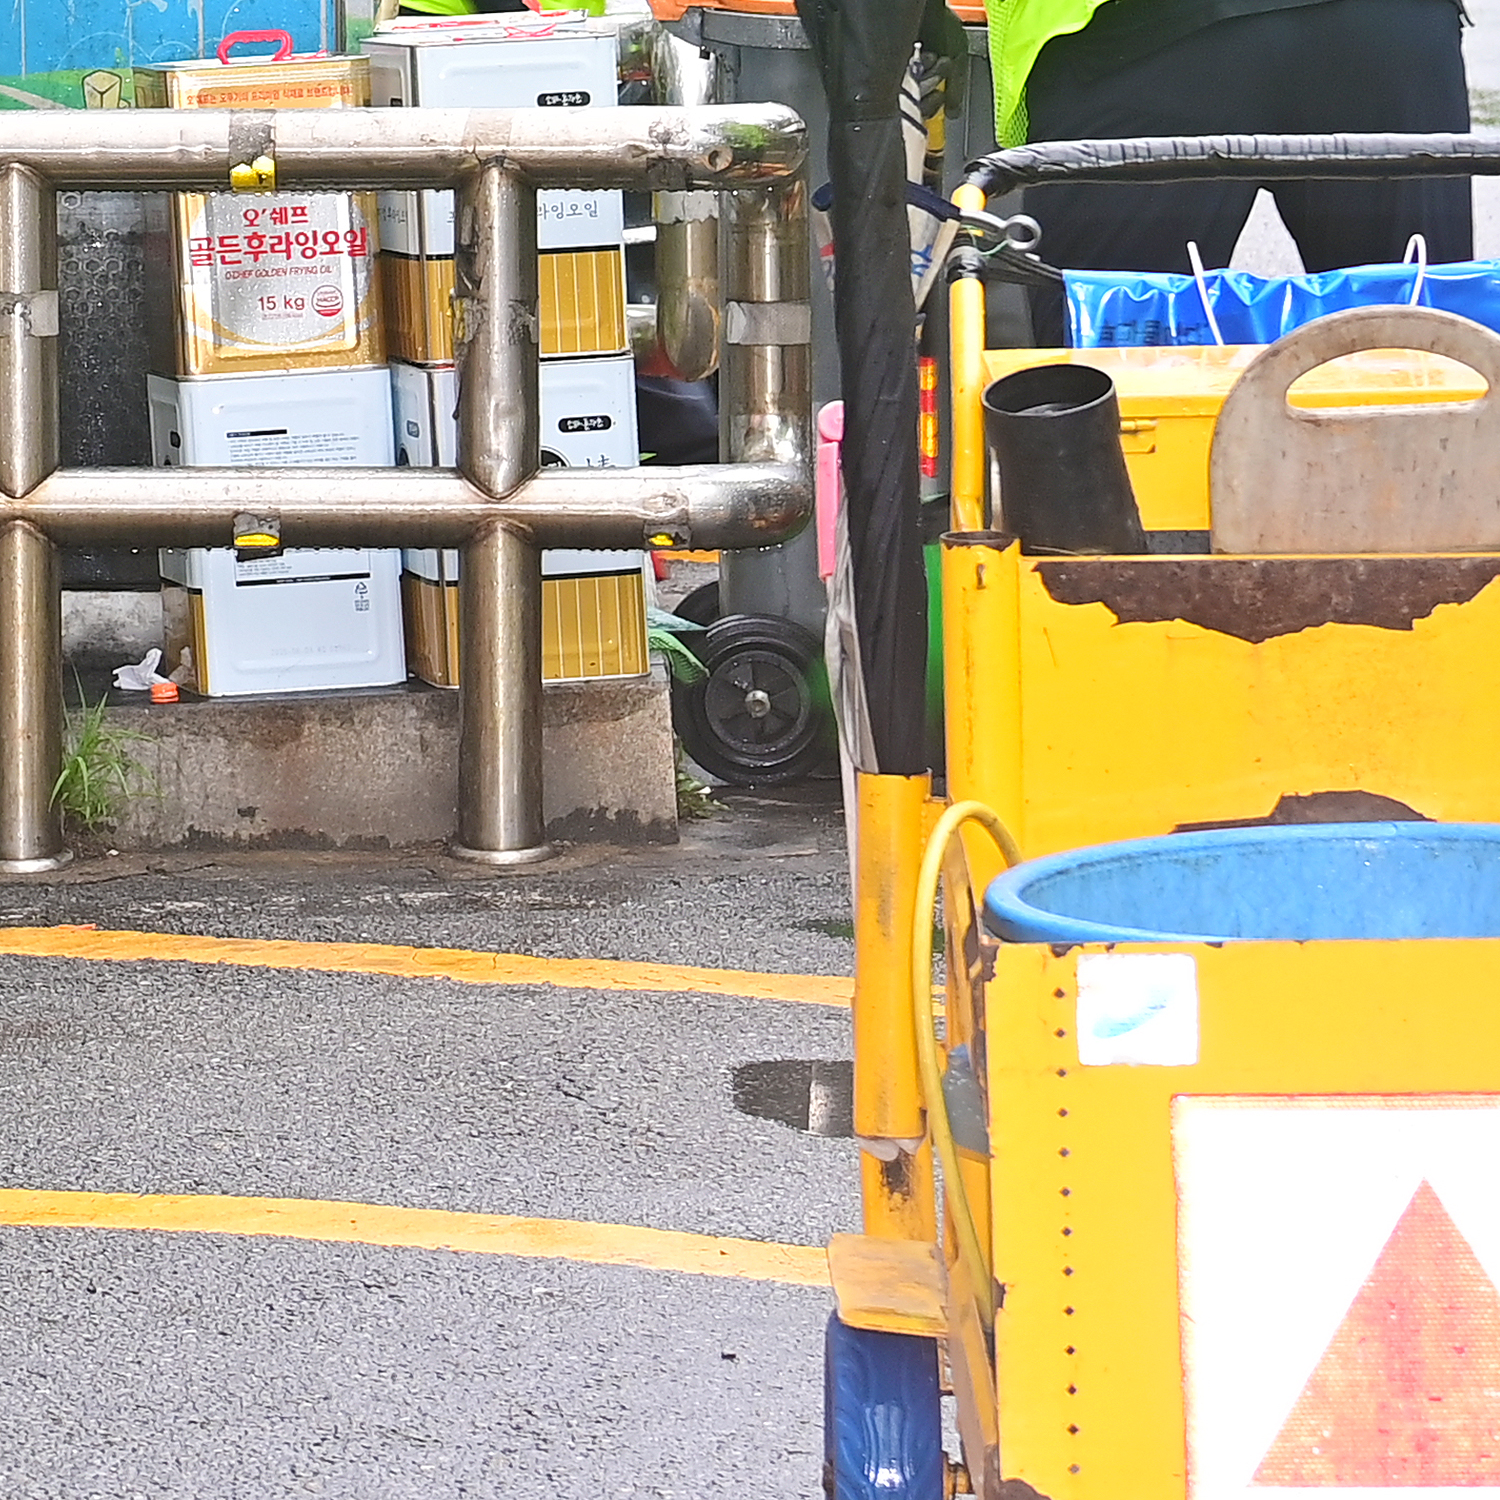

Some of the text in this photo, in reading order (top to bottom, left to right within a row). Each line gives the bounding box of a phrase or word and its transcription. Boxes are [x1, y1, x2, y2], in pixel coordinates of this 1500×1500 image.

[189, 226, 368, 267] 골든후라잉오일
[255, 267, 288, 278] GOLDEN
[289, 266, 319, 276] FRYING
[320, 265, 333, 274] OIL
[258, 295, 306, 312] 15 kg
